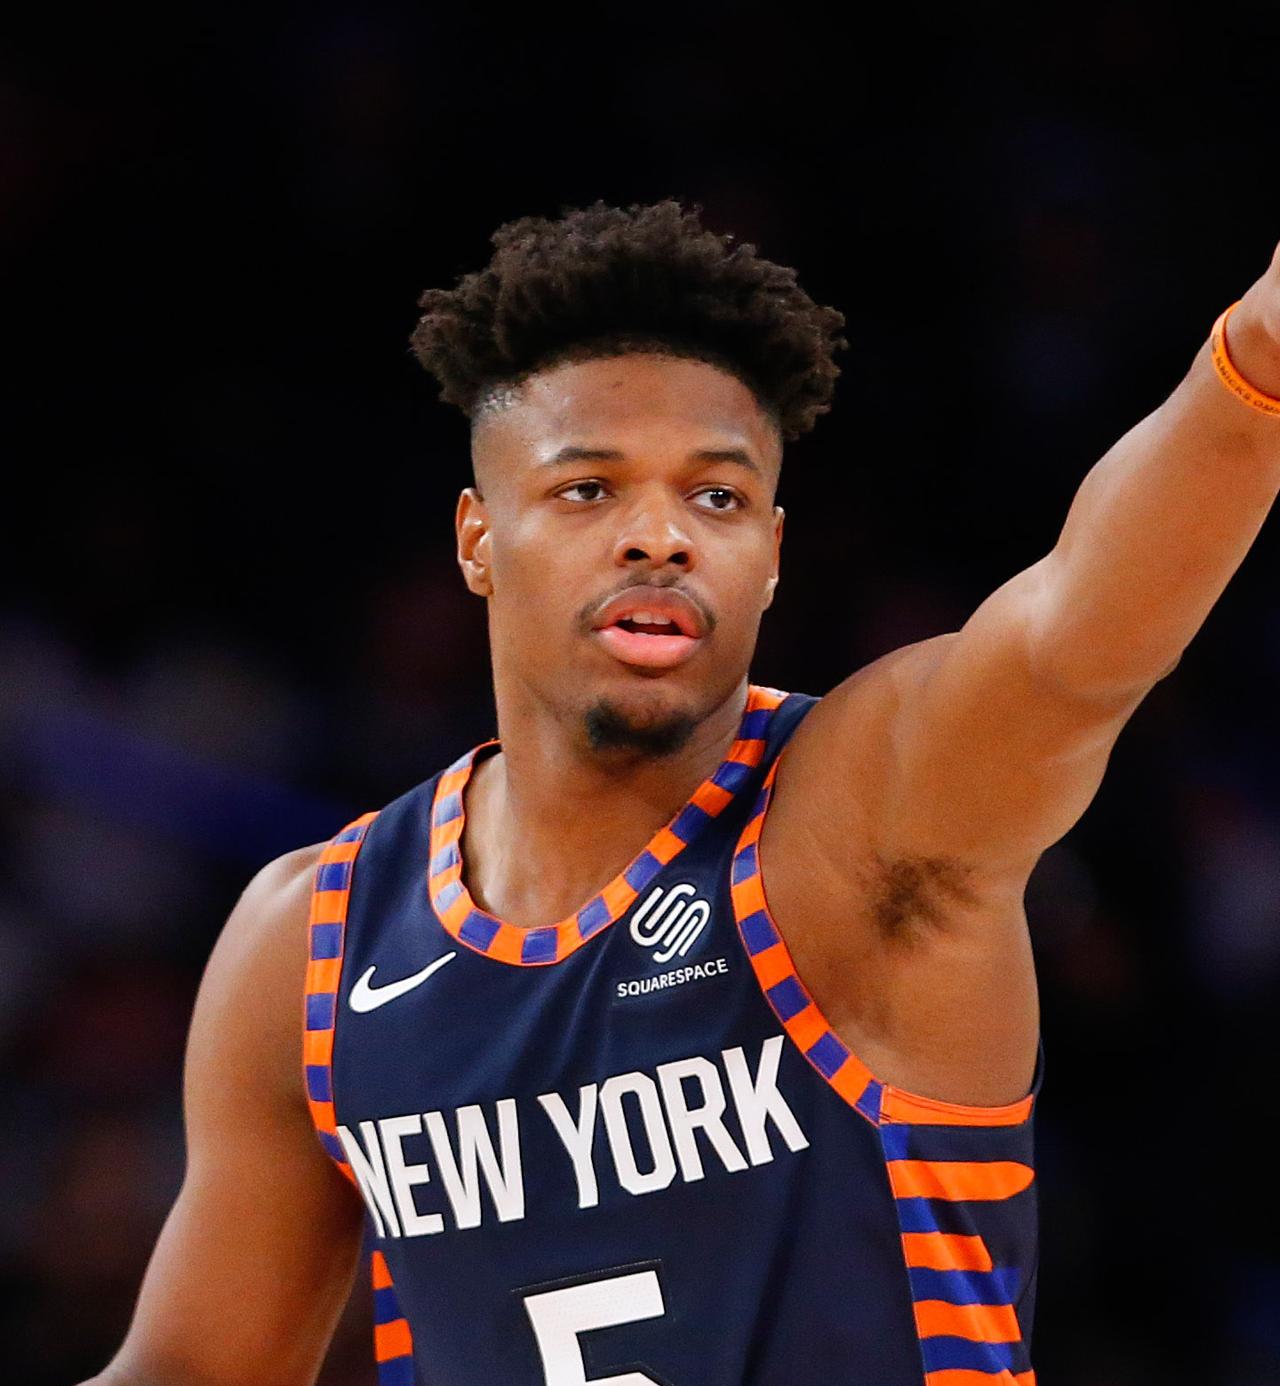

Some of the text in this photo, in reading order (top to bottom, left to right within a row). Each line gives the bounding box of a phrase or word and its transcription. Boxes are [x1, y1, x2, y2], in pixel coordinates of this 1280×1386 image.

[617, 958, 729, 997] SQUARESPACE
[336, 1034, 810, 1238] NEW YORK
